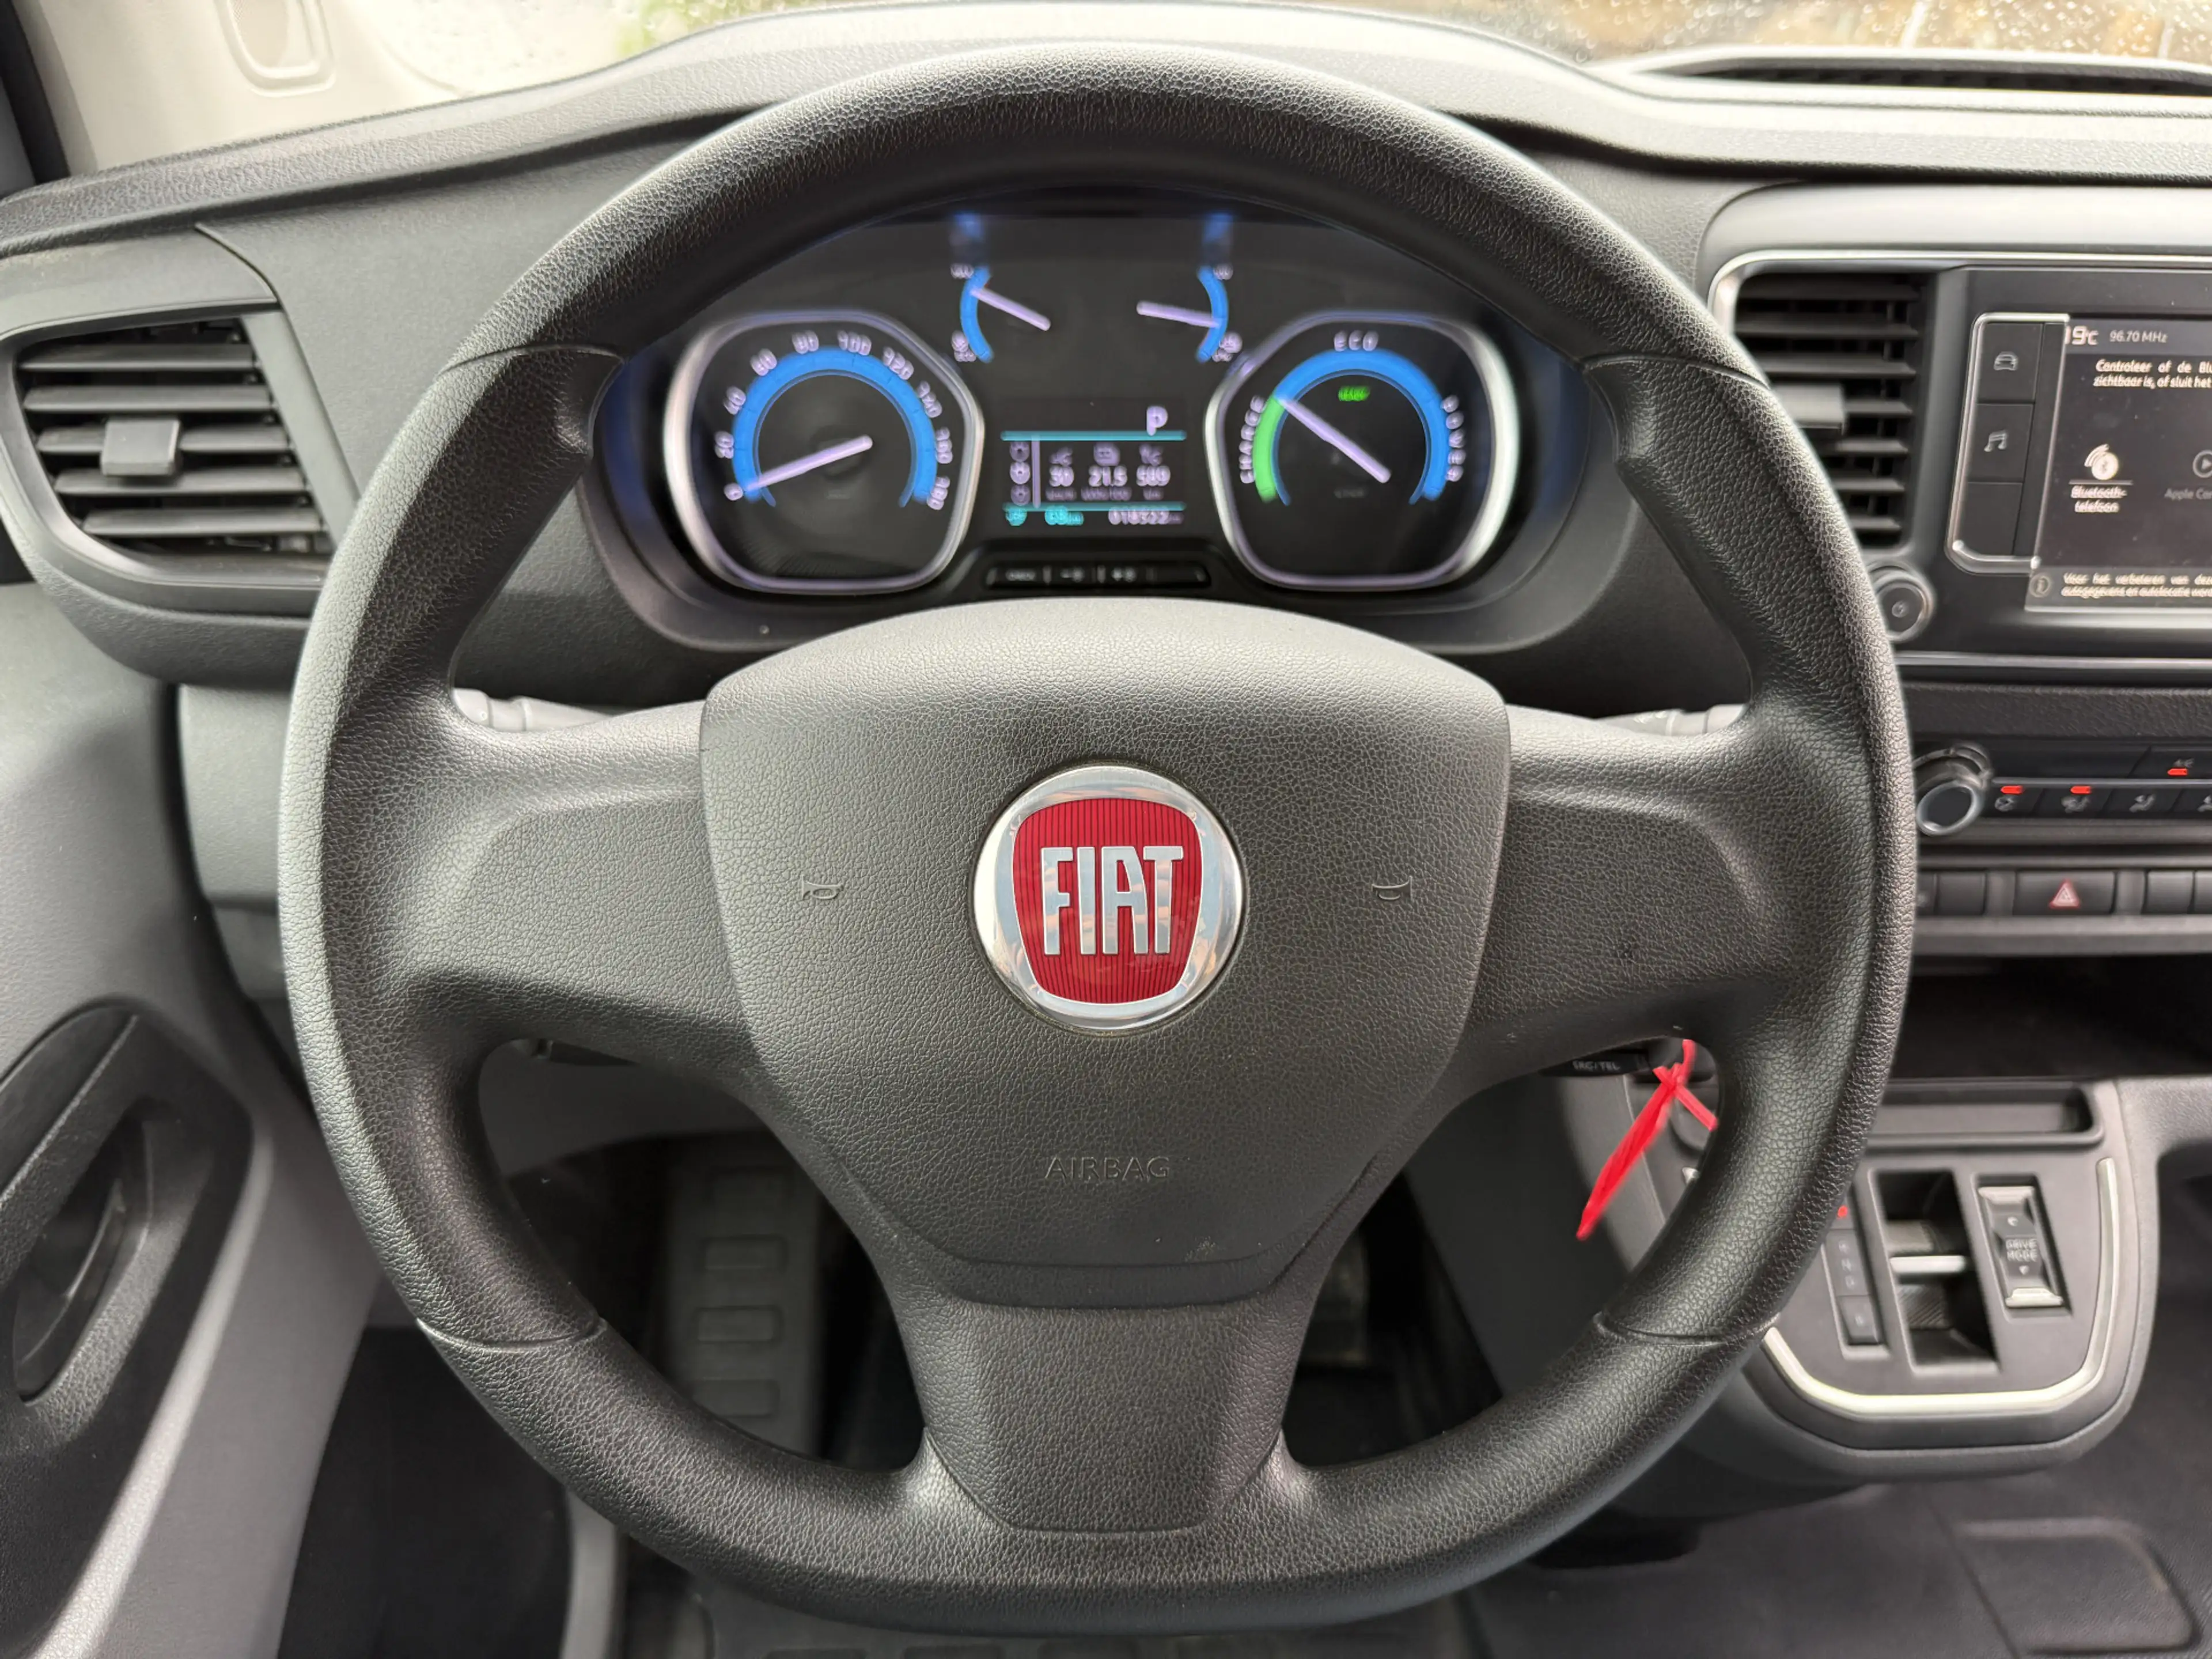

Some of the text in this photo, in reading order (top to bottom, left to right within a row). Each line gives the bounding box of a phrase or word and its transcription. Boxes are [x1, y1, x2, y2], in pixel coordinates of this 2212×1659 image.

[791, 330, 819, 354] 80
[837, 330, 872, 355] 100
[1334, 330, 1378, 352] ECO
[2109, 329, 2139, 343] 96.70
[2142, 329, 2168, 343] MHz
[750, 348, 777, 376] 60
[882, 347, 914, 380] 120
[2096, 358, 2152, 373] Controleer
[2158, 359, 2172, 373] of
[2177, 361, 2192, 373] de
[2157, 374, 2170, 388] of
[2170, 376, 2192, 388] sluit
[1146, 406, 1168, 436] P
[724, 482, 744, 501] 0
[2165, 488, 2194, 501] Apple
[1040, 846, 1183, 956] FIAT
[1044, 1156, 1169, 1182] AIRBAG
[2006, 1238, 2037, 1249] DRIVE
[2007, 1249, 2038, 1262] MODE
